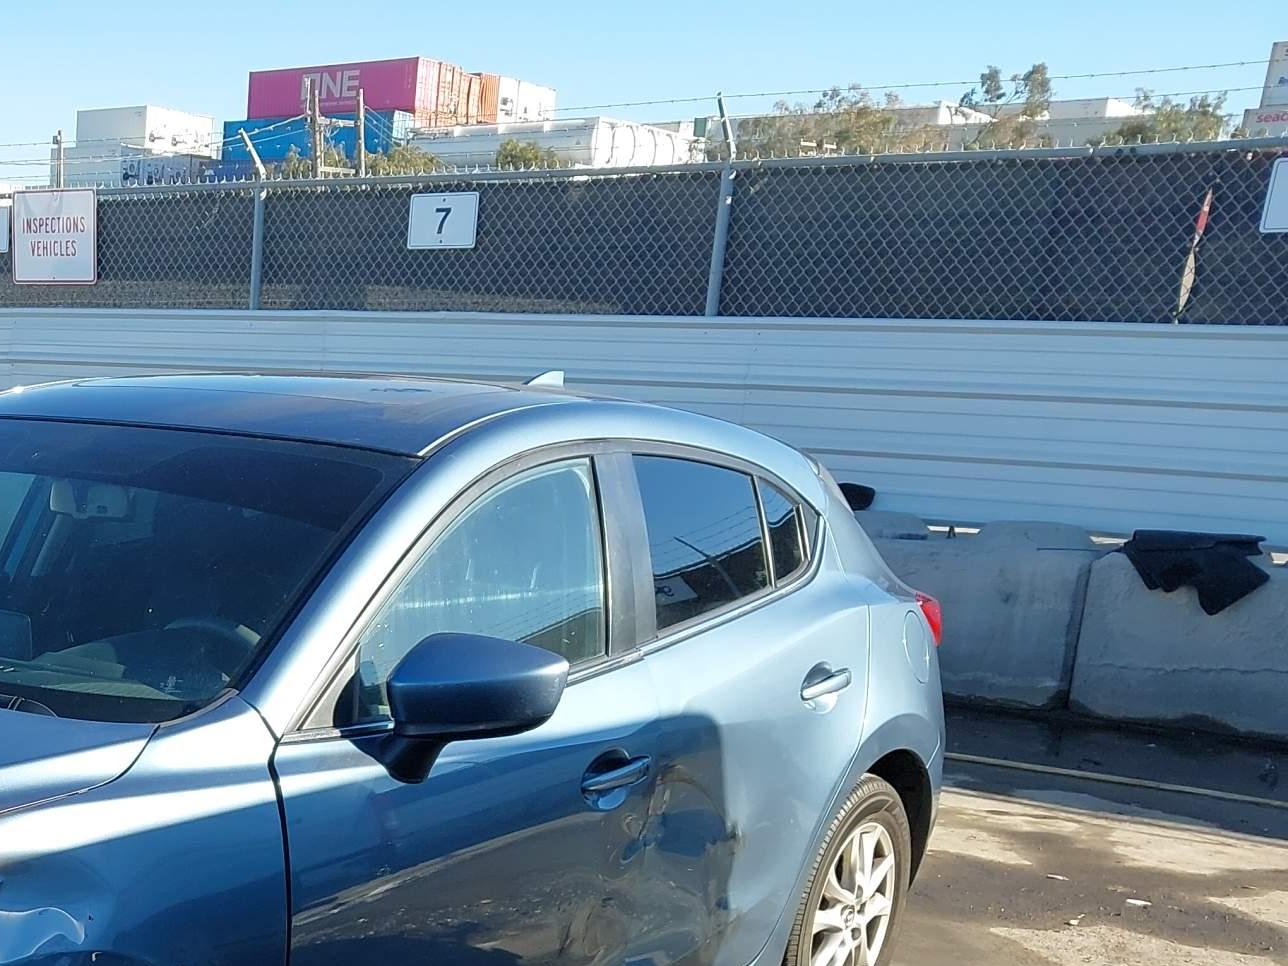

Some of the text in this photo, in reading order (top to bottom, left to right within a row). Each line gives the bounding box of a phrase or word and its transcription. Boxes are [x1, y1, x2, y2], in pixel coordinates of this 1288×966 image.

[22, 216, 86, 234] INSPECTIONS
[435, 207, 452, 235] 7
[30, 239, 77, 257] VEHICLES
